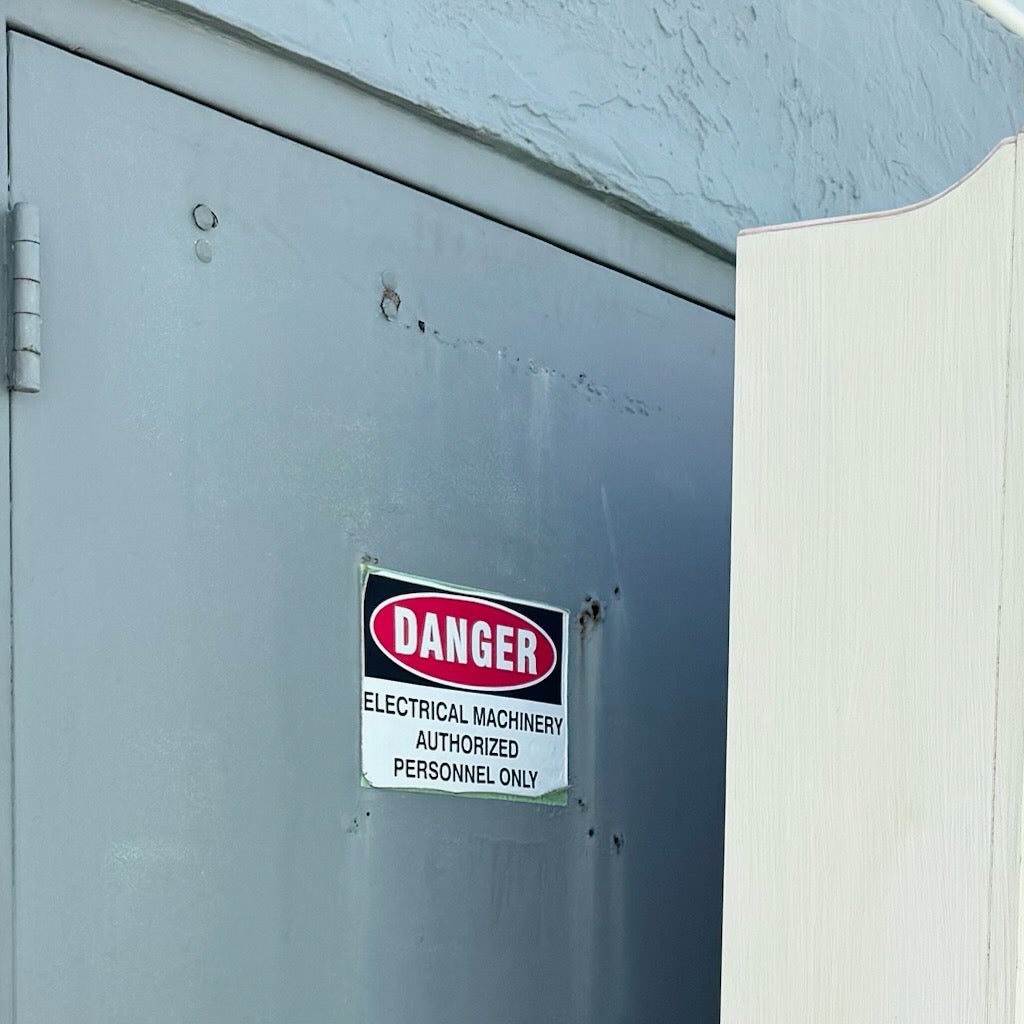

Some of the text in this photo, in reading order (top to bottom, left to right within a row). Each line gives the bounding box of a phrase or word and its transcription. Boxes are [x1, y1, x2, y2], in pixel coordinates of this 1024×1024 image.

[394, 605, 538, 675] DANGER
[364, 691, 564, 736] ELECTRICAL MACHINERY
[415, 730, 519, 759] AUTHORIZED
[394, 758, 538, 789] PERSONNEL ONLY
